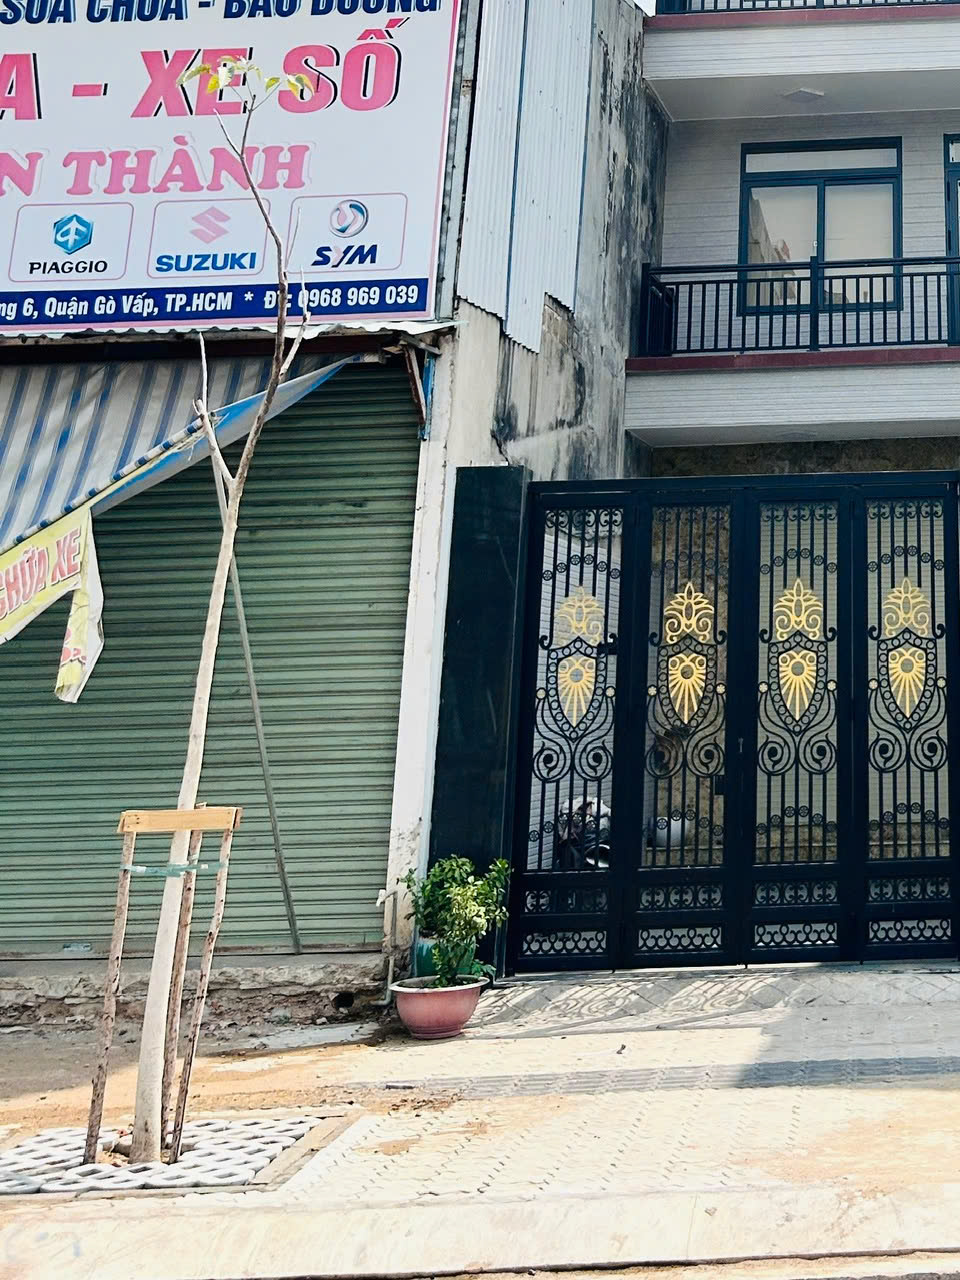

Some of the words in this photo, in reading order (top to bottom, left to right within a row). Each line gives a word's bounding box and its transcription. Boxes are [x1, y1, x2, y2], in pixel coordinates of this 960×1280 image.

[131, 47, 253, 118] XE
[277, 17, 411, 114] SỐ
[62, 134, 312, 195] THÀNH
[28, 260, 108, 275] PIAGGIO
[155, 251, 257, 273] SUZUKI
[23, 297, 38, 319] 6,
[44, 297, 89, 319] Quận
[94, 295, 116, 315] Gò
[122, 292, 159, 317] Vấp,
[165, 291, 232, 313] TP.HCM
[298, 288, 341, 307] 0968
[347, 286, 380, 305] 969
[385, 285, 418, 304] 039
[51, 527, 82, 584] XE
